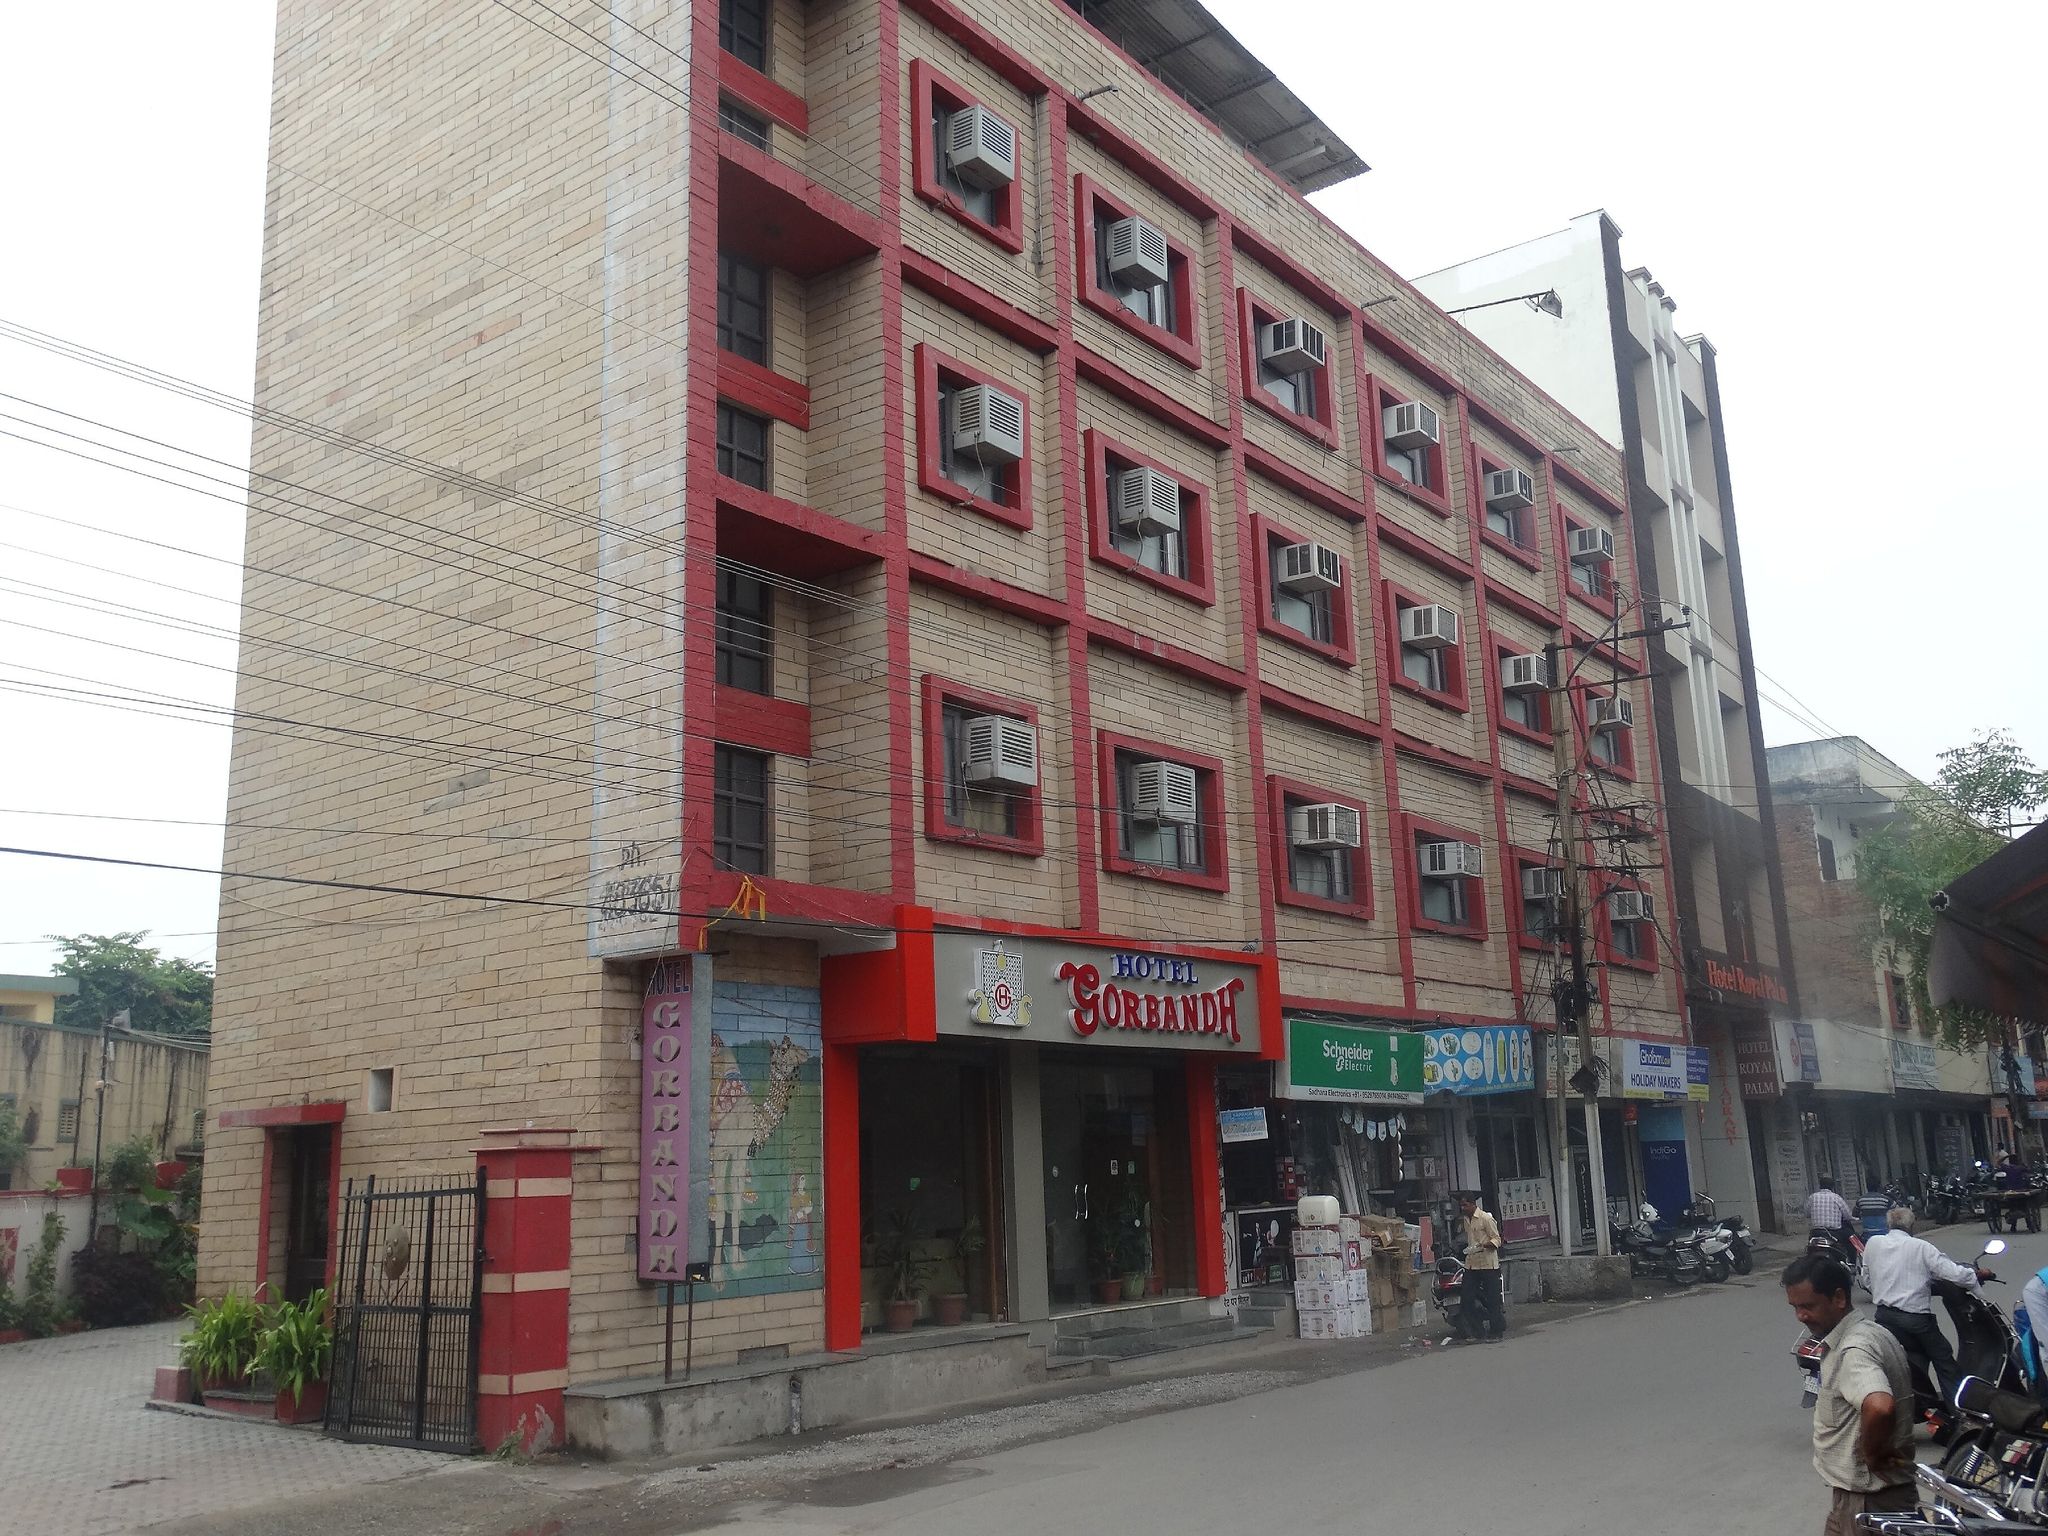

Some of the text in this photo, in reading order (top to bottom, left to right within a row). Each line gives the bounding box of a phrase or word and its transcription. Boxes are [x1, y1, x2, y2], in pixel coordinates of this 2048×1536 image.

[1111, 953, 1199, 985] HOTEL
[1705, 959, 1737, 992] Hotel
[1054, 961, 1245, 1044] GORBANDH
[1322, 1039, 1373, 1061] Schneider
[1737, 1040, 1771, 1054] HOTEL
[1345, 1059, 1373, 1072] Electric
[1739, 1061, 1775, 1075] ROYAL
[1630, 1073, 1681, 1089] HOLIDAY MAKERS
[1744, 1081, 1774, 1095] PALM
[649, 1001, 682, 1274] GORBANDH
[1650, 1146, 1677, 1154] IndiGo
